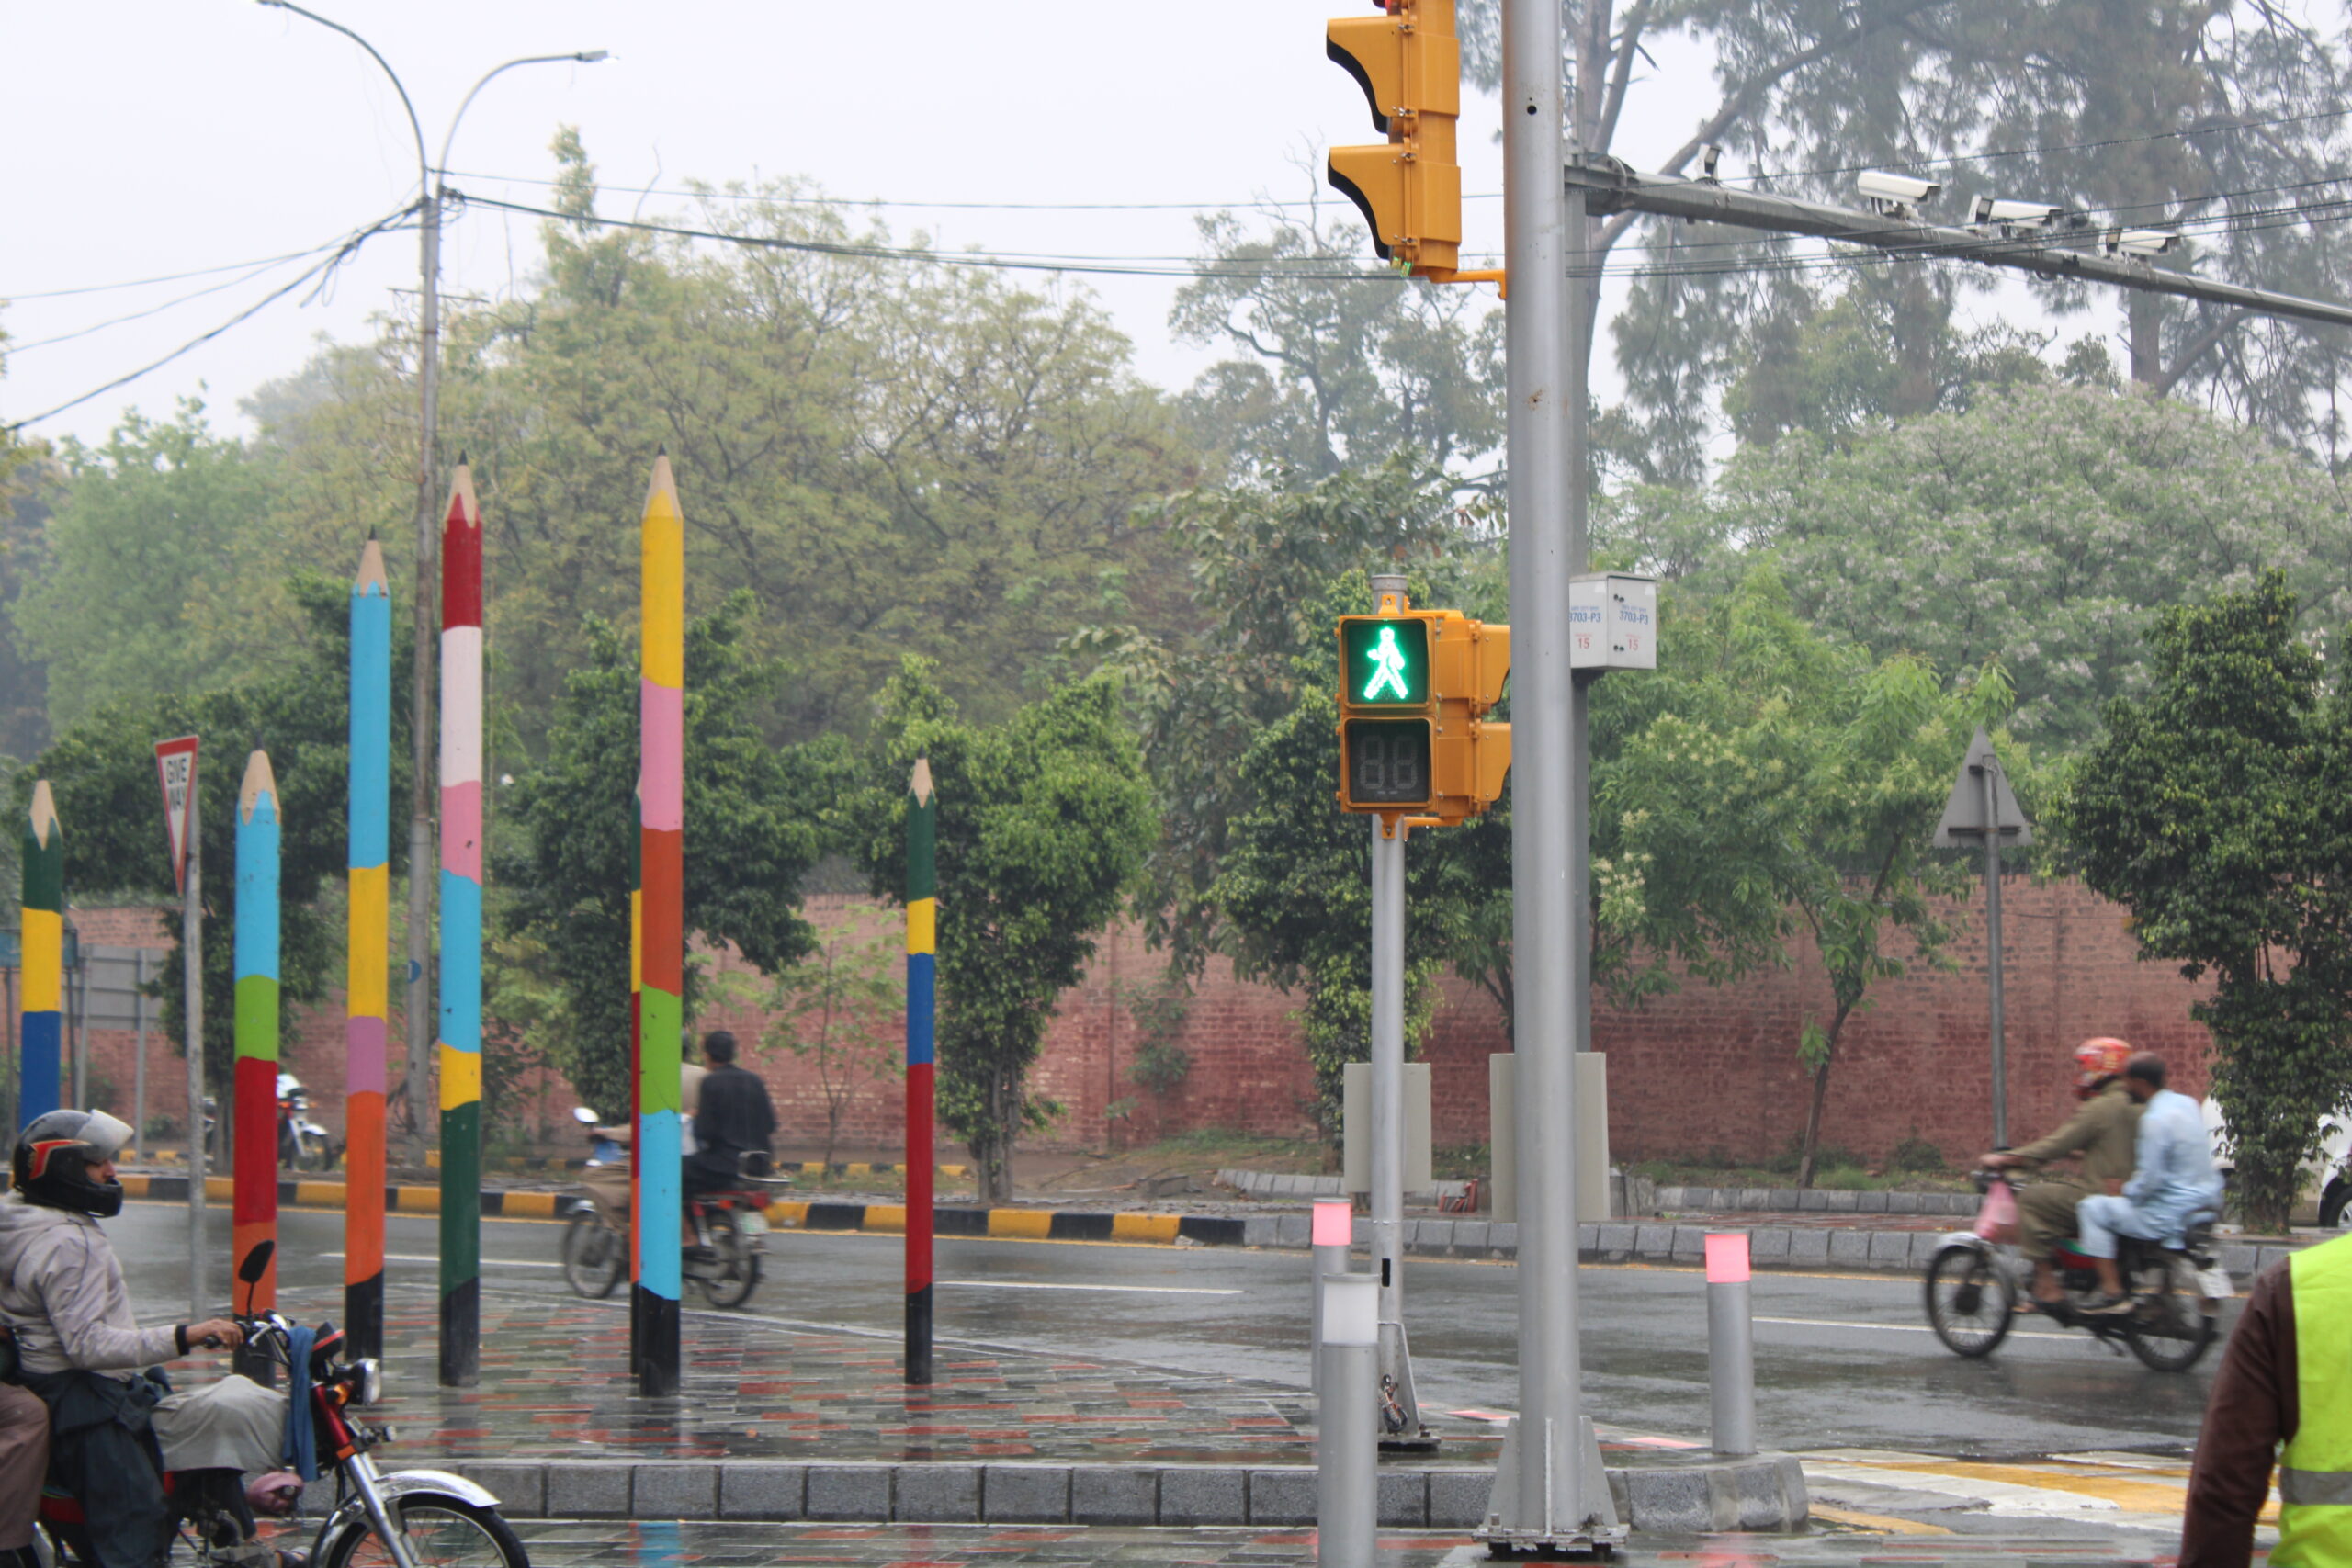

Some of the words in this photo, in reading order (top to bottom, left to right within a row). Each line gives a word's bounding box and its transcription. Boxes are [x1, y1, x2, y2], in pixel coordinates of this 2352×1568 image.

[1619, 610, 1649, 626] 3703-P3
[1577, 637, 1590, 650] 15
[1628, 638, 1639, 651] 15
[165, 758, 187, 784] GIVE
